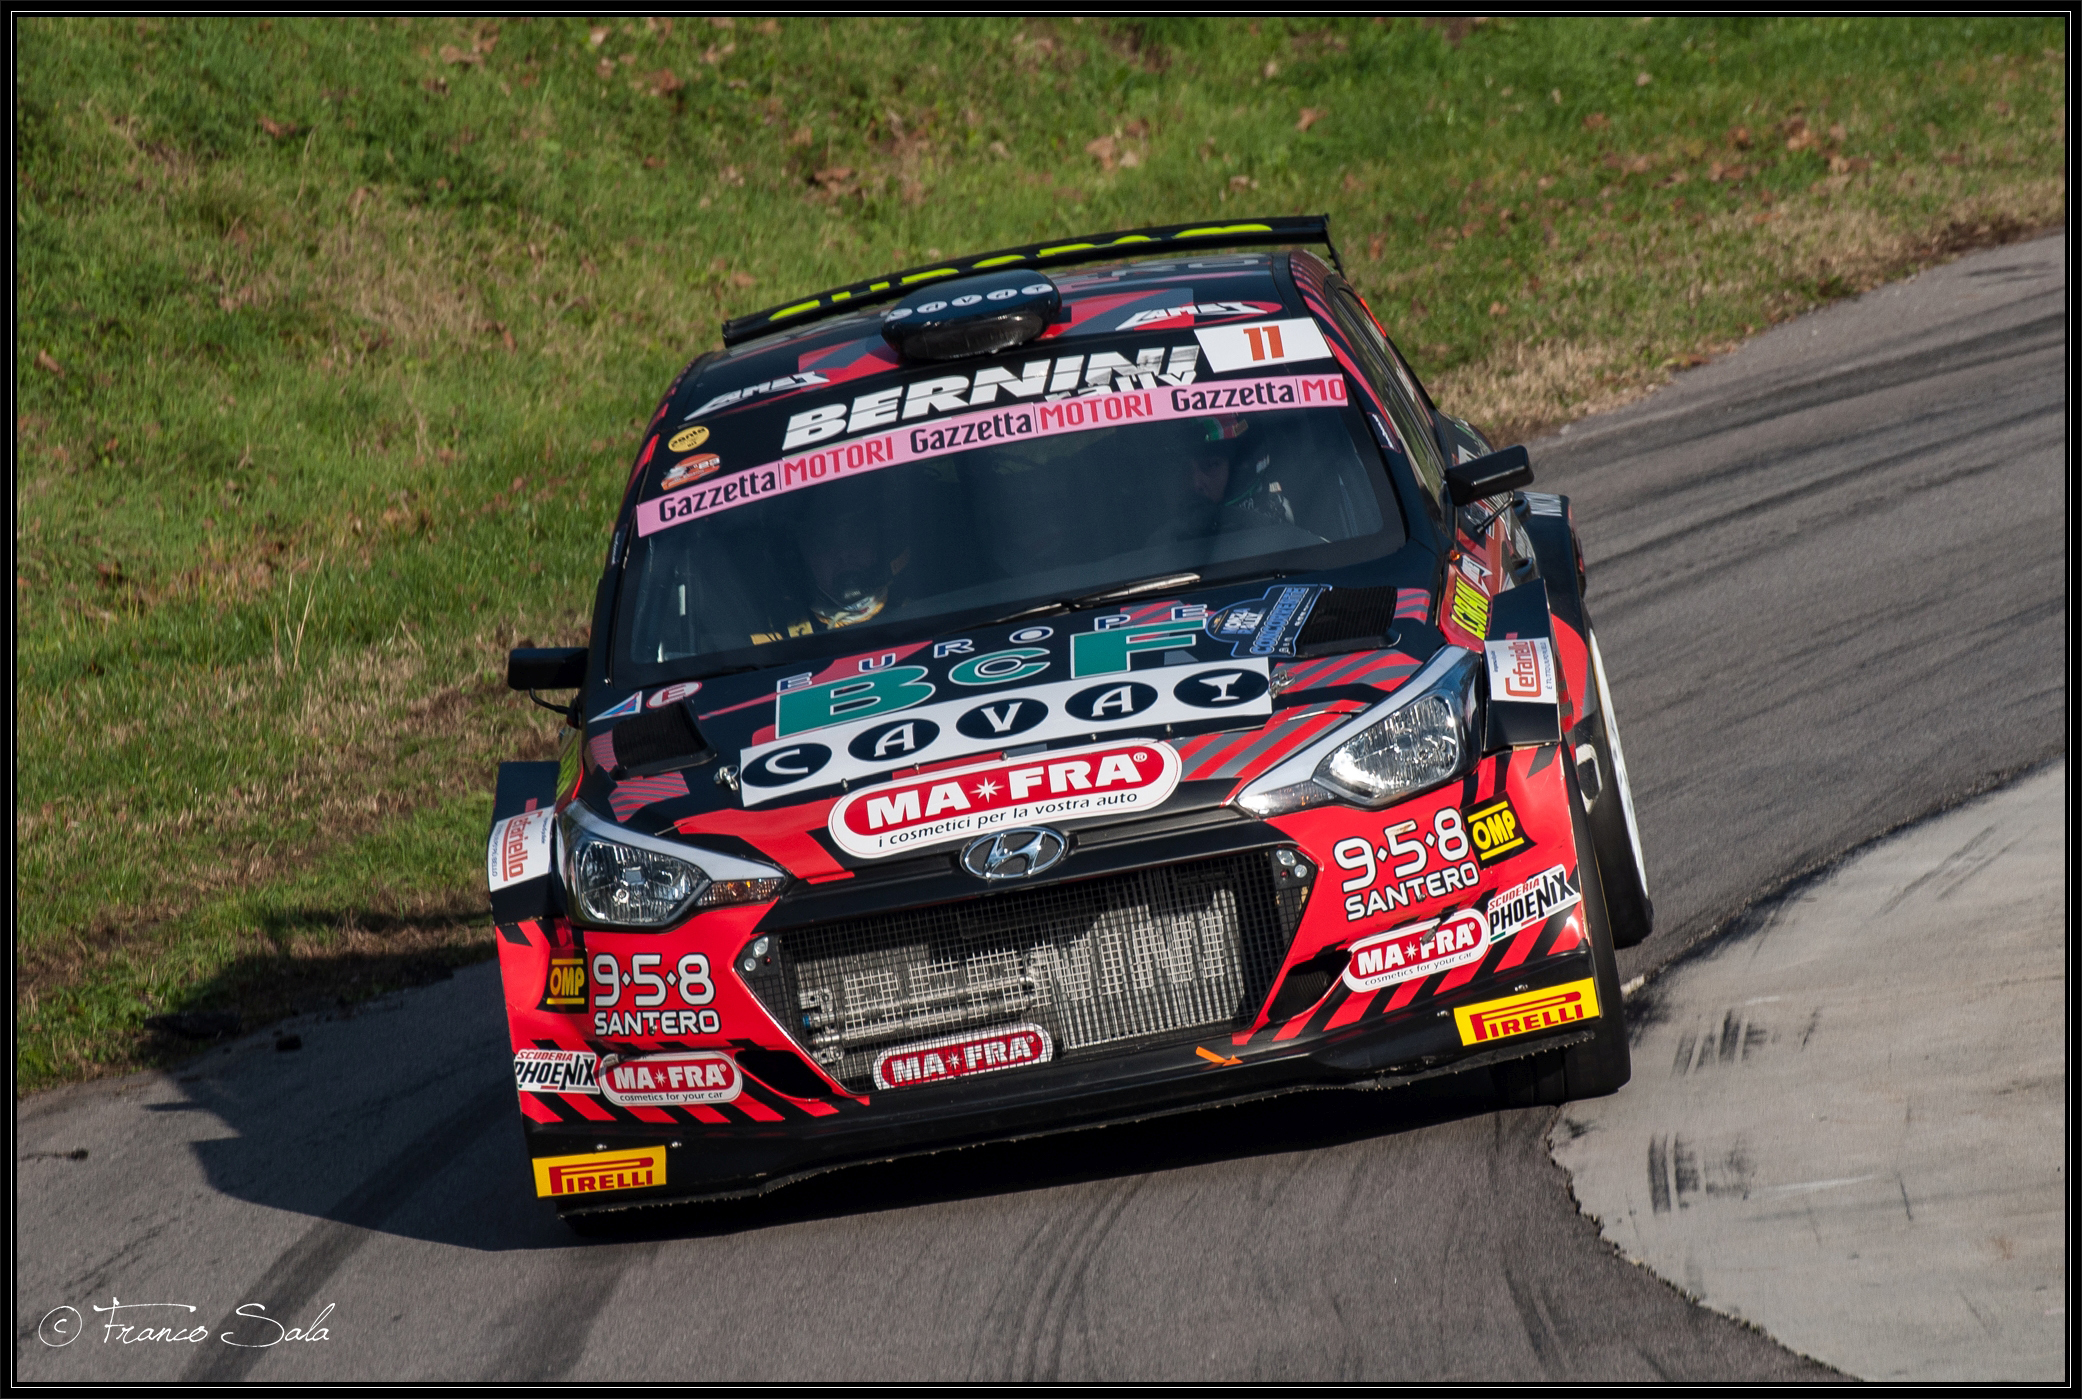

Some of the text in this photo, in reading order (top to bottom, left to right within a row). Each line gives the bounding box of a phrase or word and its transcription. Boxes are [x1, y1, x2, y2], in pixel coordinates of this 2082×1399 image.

[1244, 326, 1284, 361] 11
[782, 345, 1199, 450] BERNINI
[659, 469, 775, 522] Gazzetta
[784, 437, 894, 486] MOTORI
[910, 412, 1032, 453] Gazzetta
[1039, 393, 1153, 430] MOTORI
[1171, 382, 1294, 411] Gazzetta
[1302, 379, 1347, 402] MO
[776, 604, 1208, 692] EUROPE
[764, 672, 1243, 775] CAVAY
[879, 791, 1138, 848] i cosmetici per la vostra auto
[1472, 810, 1517, 850] OMP
[1345, 861, 1480, 921] SANTERO
[1488, 878, 1541, 910] SCUDERIA
[550, 966, 585, 996] OMP
[1364, 951, 1473, 986] cosmetics for your car
[594, 1009, 721, 1036] SANTERO
[1469, 991, 1585, 1042] PIRELLI
[517, 1051, 574, 1061] SCUDERIA
[619, 1091, 723, 1103] cosmetics for your car
[548, 1156, 654, 1195] PIRELLI
